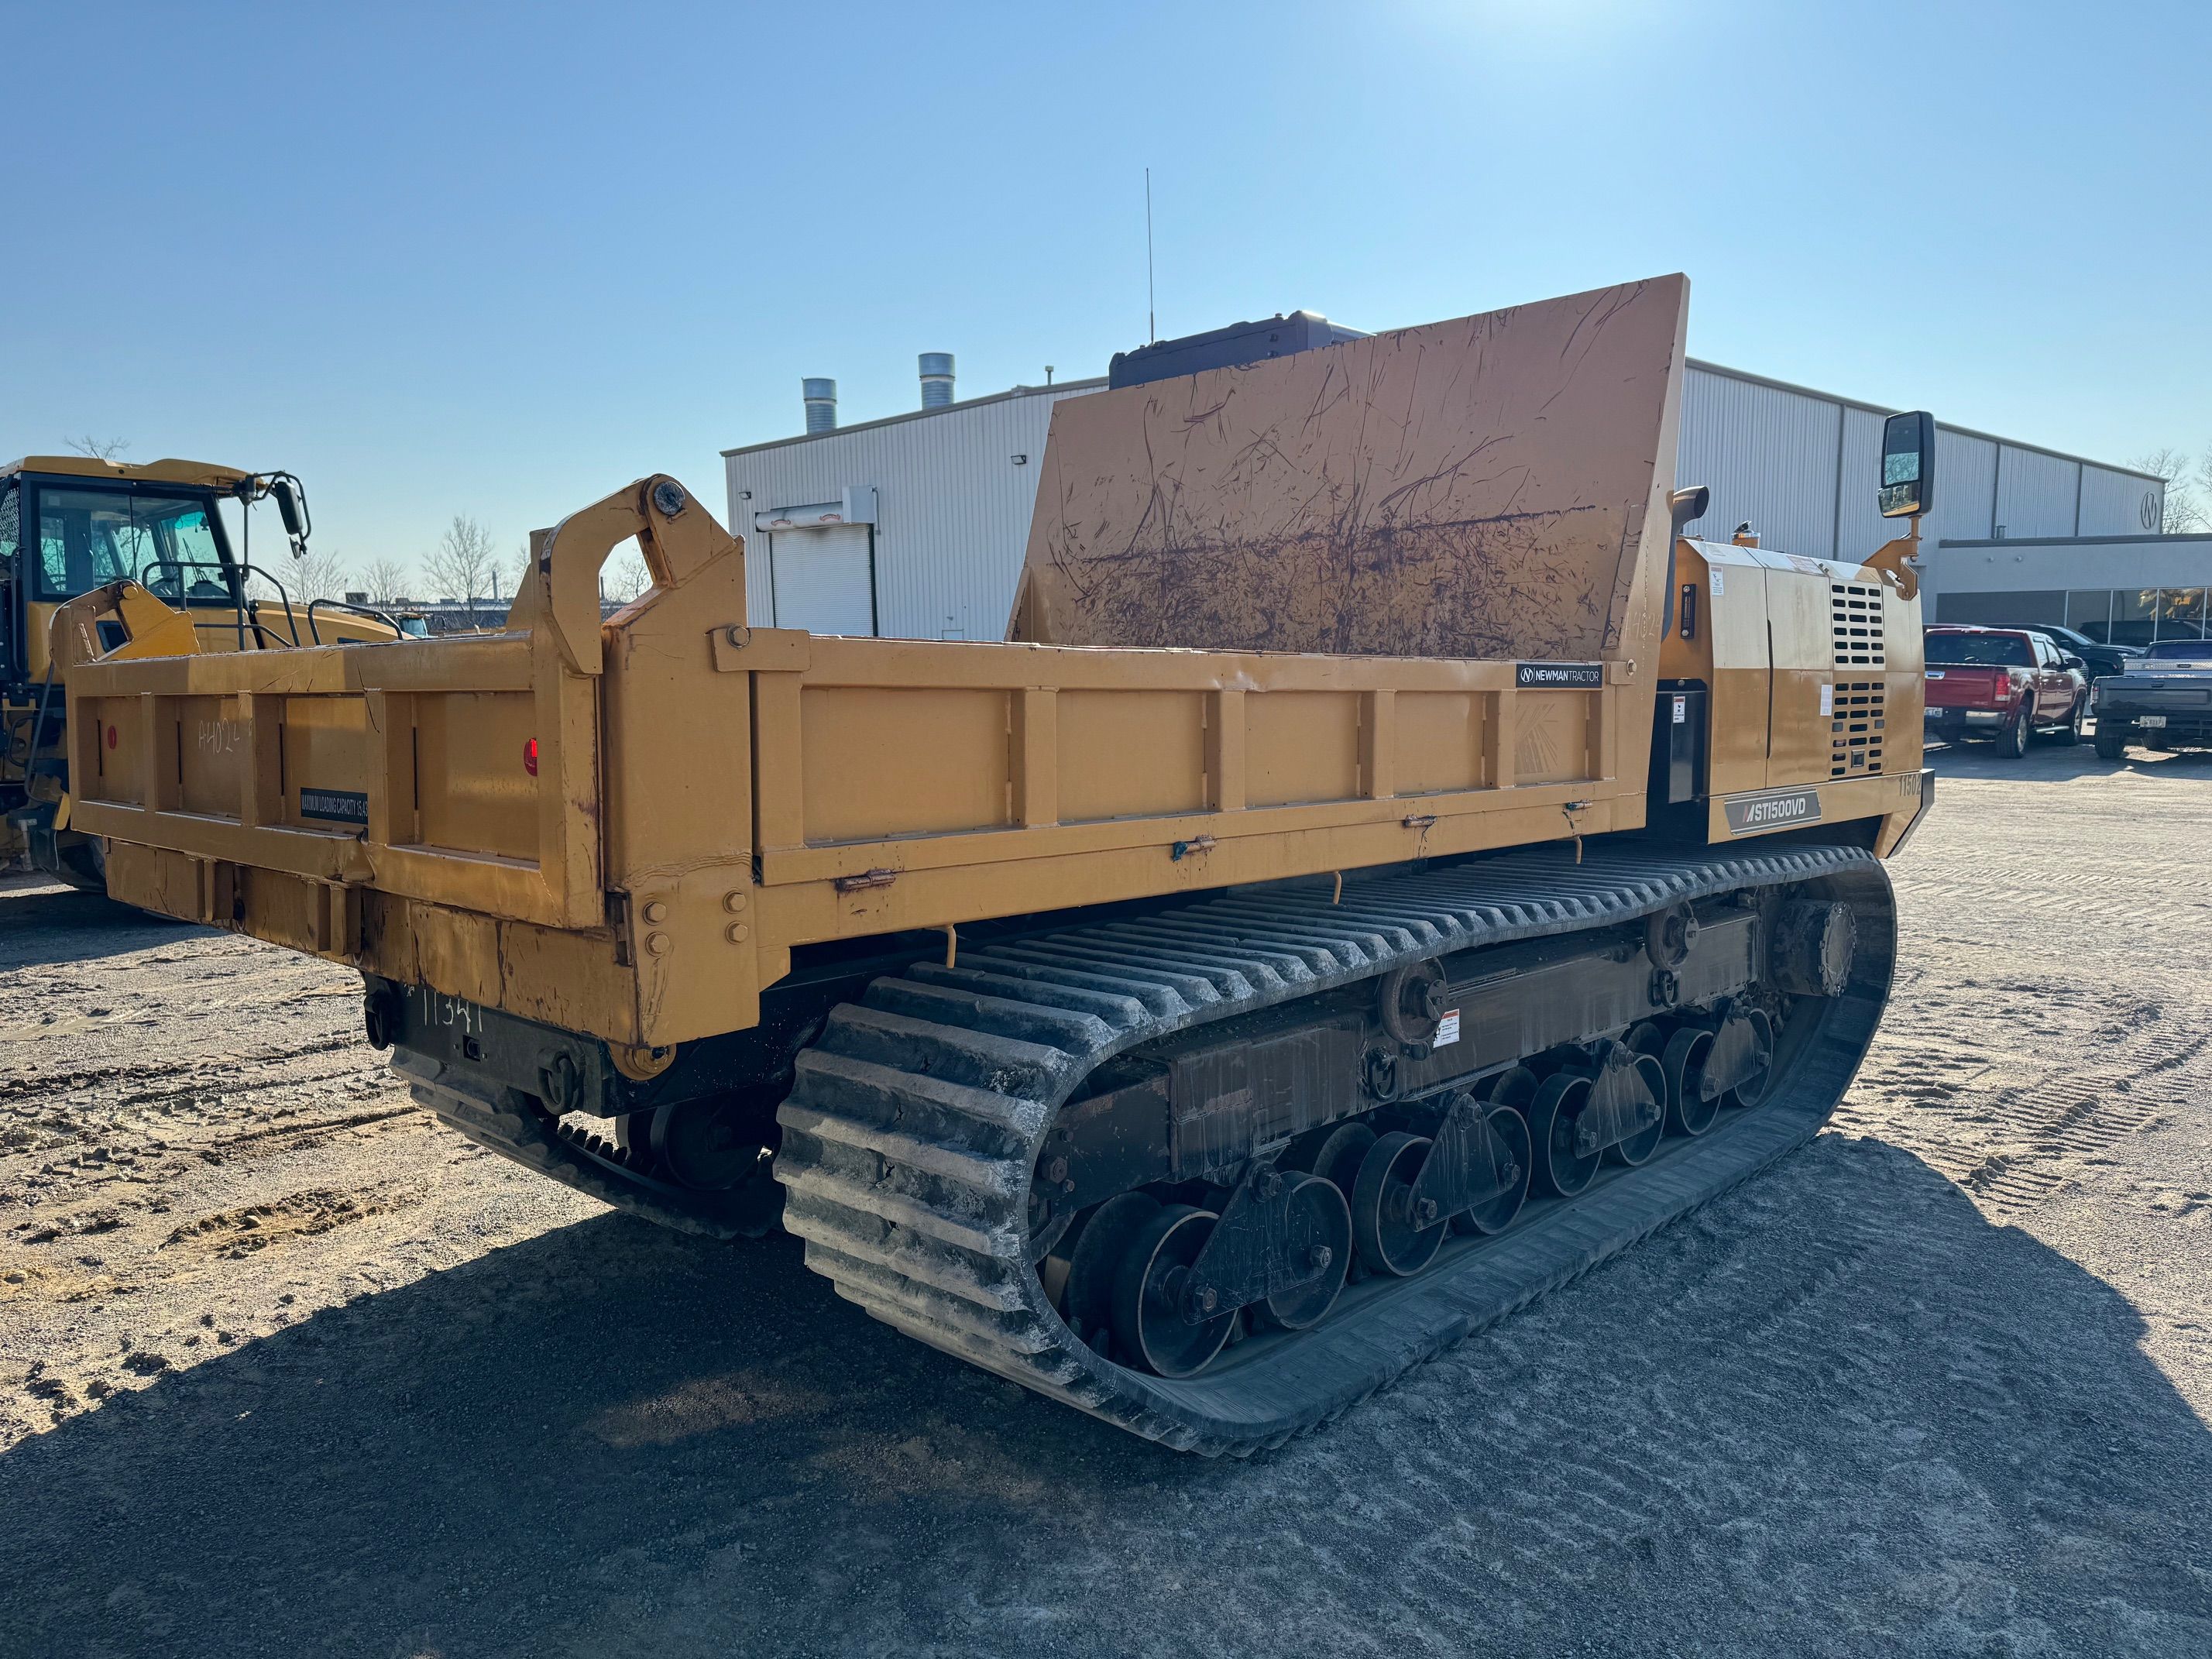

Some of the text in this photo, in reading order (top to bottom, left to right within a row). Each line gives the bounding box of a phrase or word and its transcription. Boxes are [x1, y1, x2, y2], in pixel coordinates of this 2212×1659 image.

[301, 794, 318, 812] MAXIMUM
[319, 795, 336, 813] LOADING
[336, 797, 356, 816] CAPACITY
